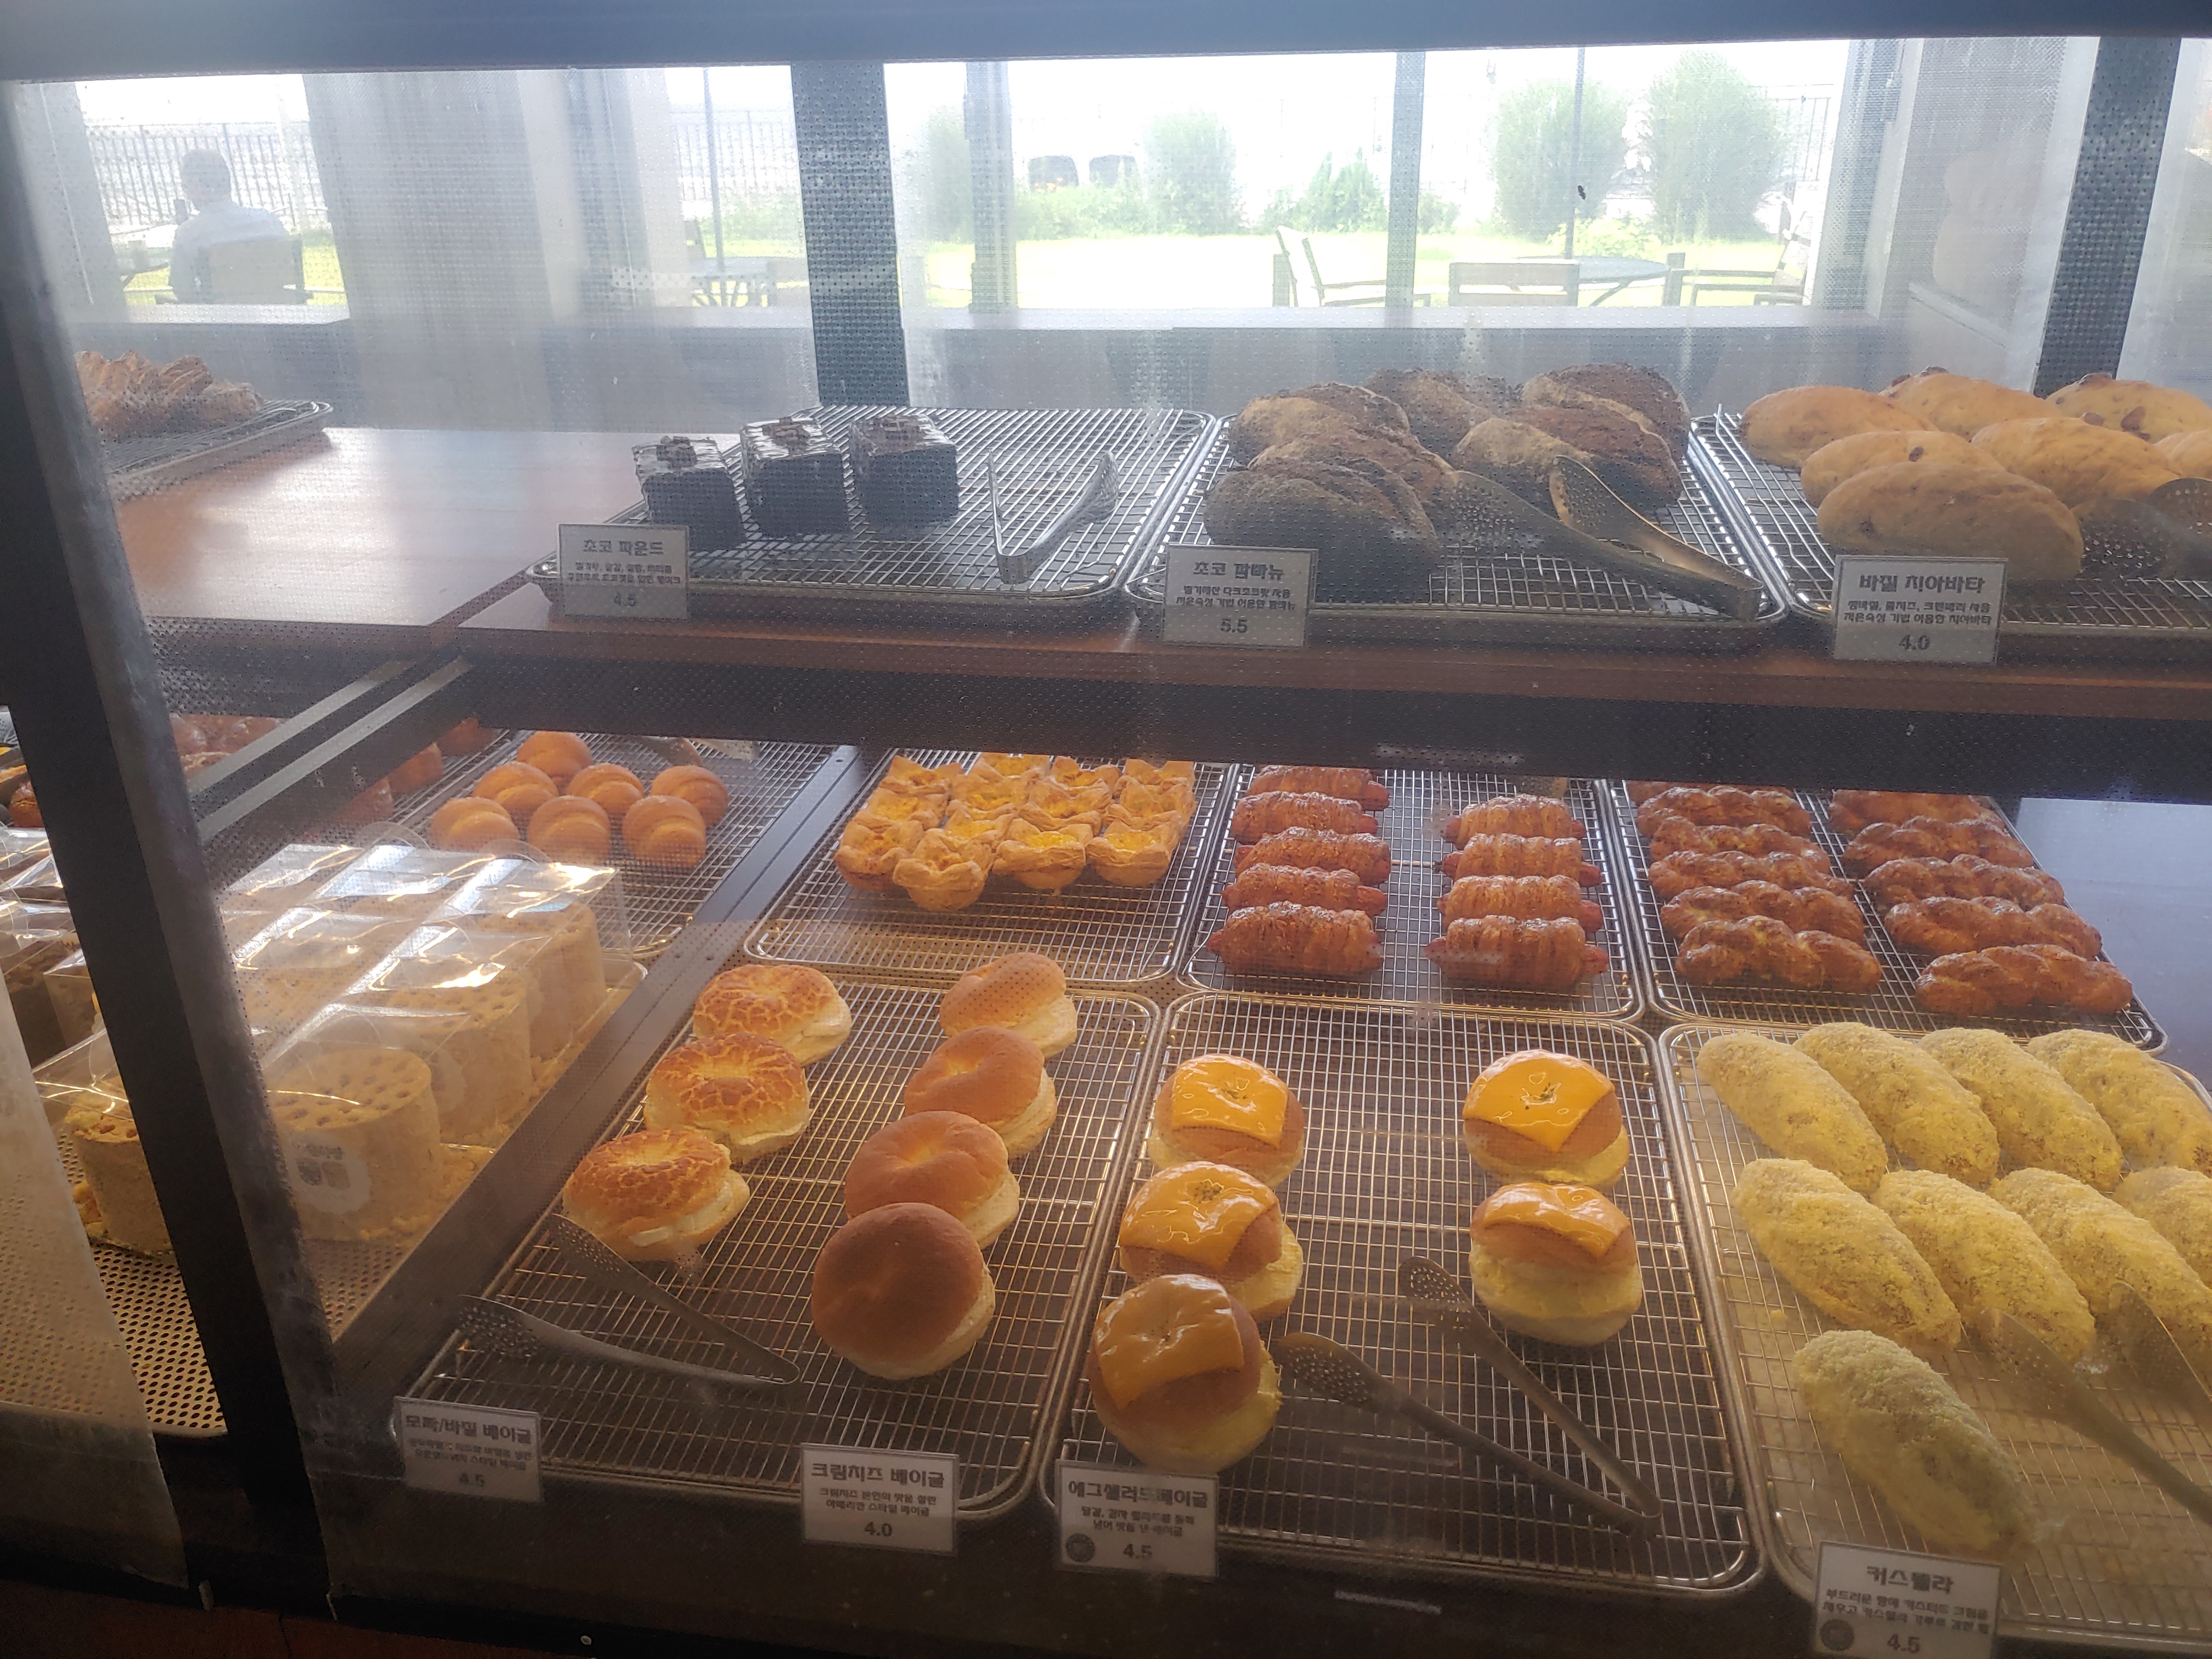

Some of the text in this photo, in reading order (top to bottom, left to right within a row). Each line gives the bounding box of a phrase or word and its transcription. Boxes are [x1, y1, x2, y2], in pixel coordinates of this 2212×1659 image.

[583, 539, 664, 556] 초코 파운드
[1193, 561, 1227, 575] 초코
[1859, 575, 1985, 594] 바질 치아바타
[1272, 589, 1290, 598] 사용
[1176, 597, 1213, 607] 저온숙성
[1217, 598, 1234, 607] 기법
[1969, 602, 1991, 613] 사용
[1220, 618, 1248, 633] 5.5
[1843, 613, 1992, 625] 저온숙성 기법 이용한 치아바타
[1899, 634, 1930, 650] 4.0
[483, 1424, 531, 1443] 베이글
[459, 1472, 485, 1487] 4.5
[811, 1463, 944, 1488] 크림치즈 베이글
[820, 1488, 936, 1505] 크림치즈 본연의 맛을 살린
[826, 1499, 929, 1516] 아메리칸 스타일 베이글
[864, 1521, 892, 1537] 4.0
[1123, 1544, 1153, 1559] 4.5
[1826, 1588, 1872, 1603] 부드러운
[1887, 1633, 1920, 1654] 4.5
